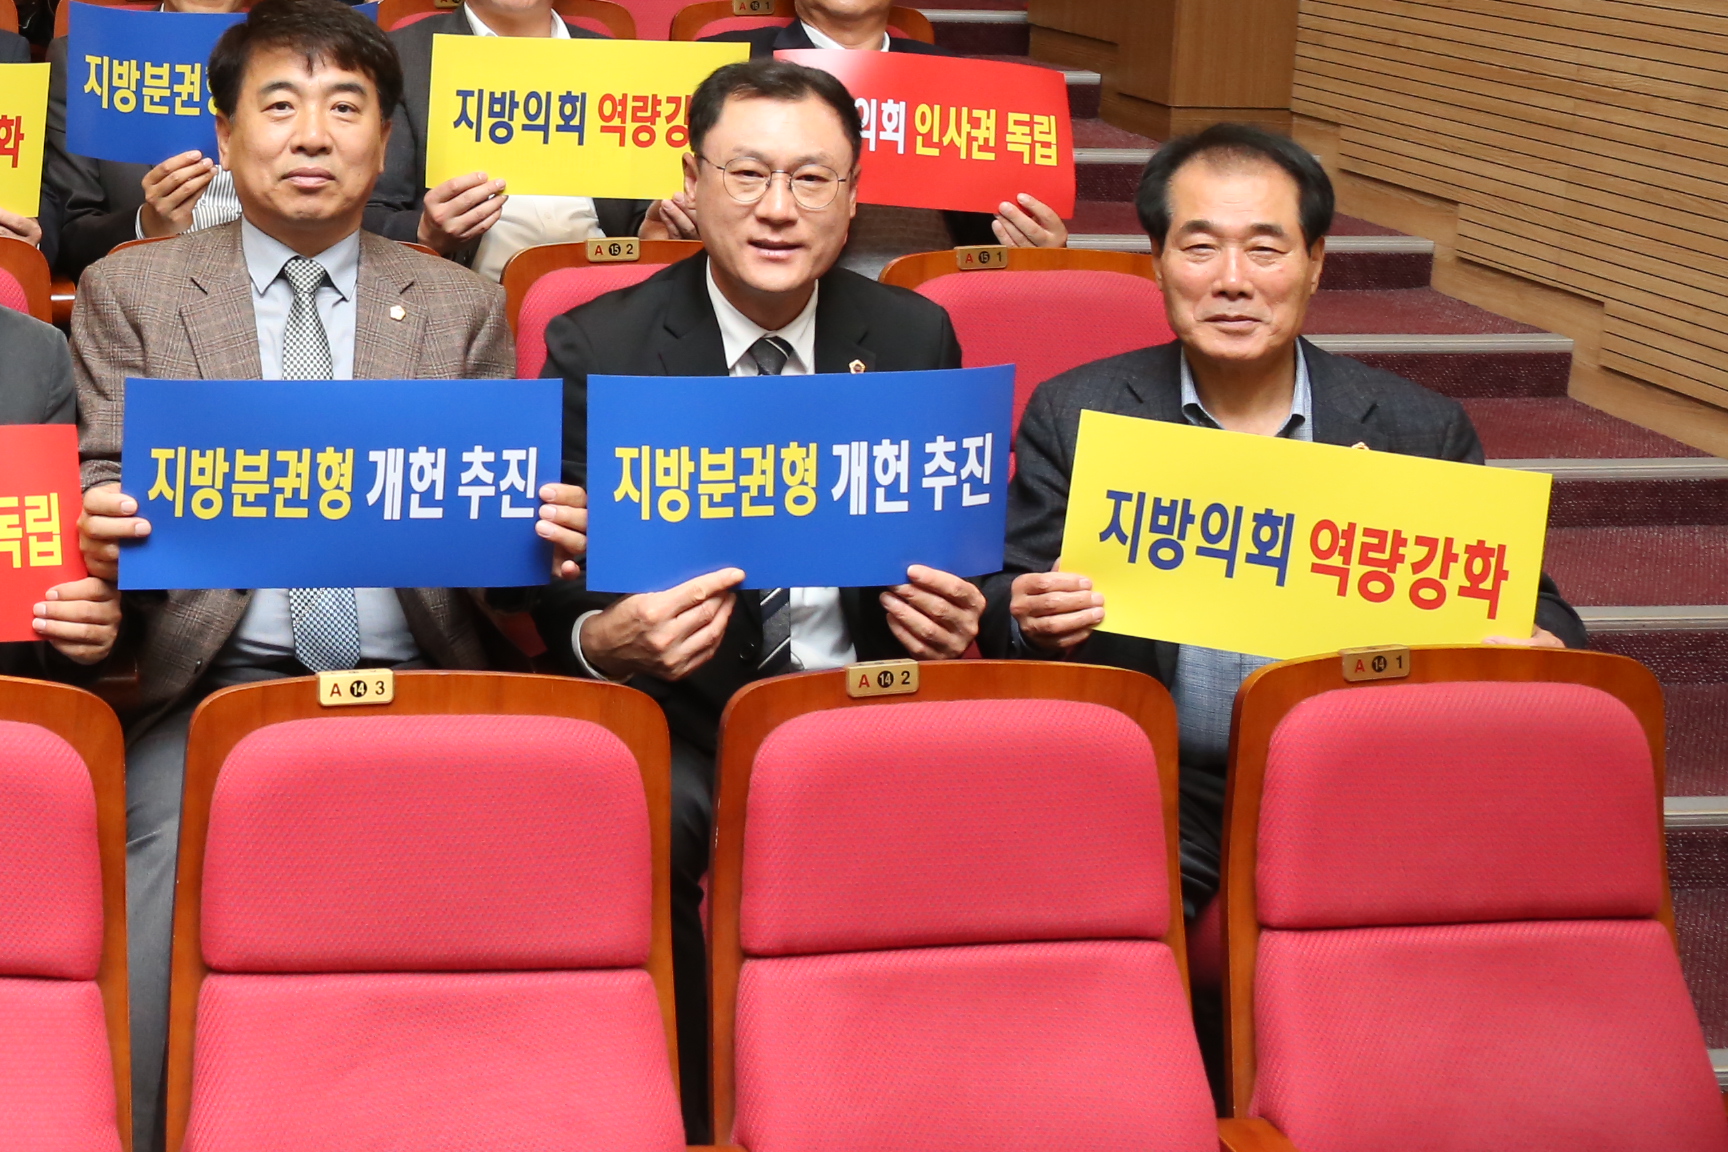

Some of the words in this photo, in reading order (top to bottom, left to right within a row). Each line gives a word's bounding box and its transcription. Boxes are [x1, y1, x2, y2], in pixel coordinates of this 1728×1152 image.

[86, 56, 217, 115] 지방분권
[454, 90, 586, 145] 지방의회
[599, 94, 691, 147] 역량강
[855, 98, 905, 154] 의회
[915, 104, 996, 160] 인사권
[1006, 113, 1057, 166] 독립
[595, 245, 603, 255] A
[626, 244, 633, 254] 2
[965, 253, 973, 263] A
[150, 448, 353, 519] 지방분권형
[367, 447, 445, 519] 개헌
[458, 446, 537, 519] 추진
[616, 444, 816, 521] 지방분권형
[832, 439, 909, 514] 개헌
[923, 433, 992, 510] 추진
[1100, 491, 1294, 586] 지방의회
[1311, 520, 1508, 619] 역량강화
[330, 683, 342, 697] A
[375, 681, 385, 695] 3
[858, 674, 870, 688] A
[901, 671, 910, 684] 2
[1354, 659, 1365, 673] A
[1396, 655, 1402, 669] 1
